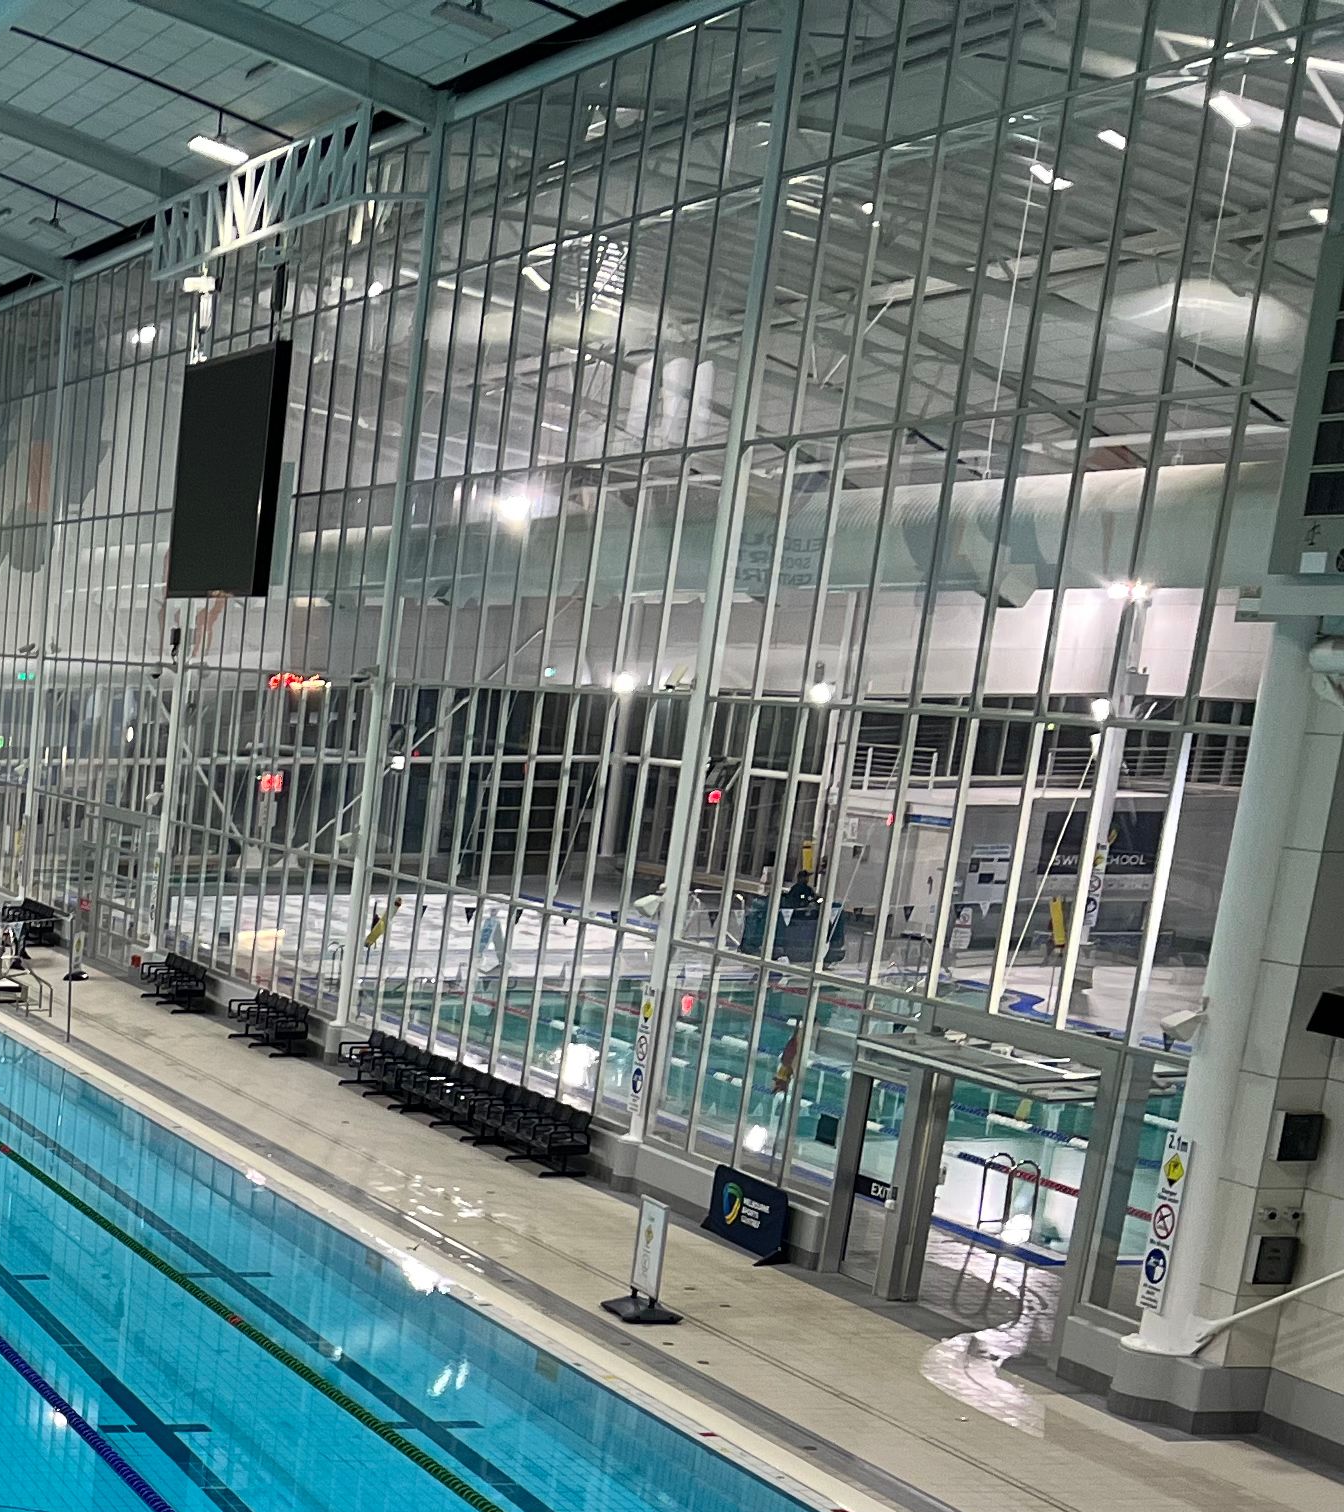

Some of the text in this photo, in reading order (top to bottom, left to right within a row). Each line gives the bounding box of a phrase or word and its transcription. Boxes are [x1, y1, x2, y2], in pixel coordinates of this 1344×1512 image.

[1106, 854, 1147, 866] CHOOL
[1168, 1134, 1189, 1152] 2.1m
[870, 1182, 891, 1200] EXIT
